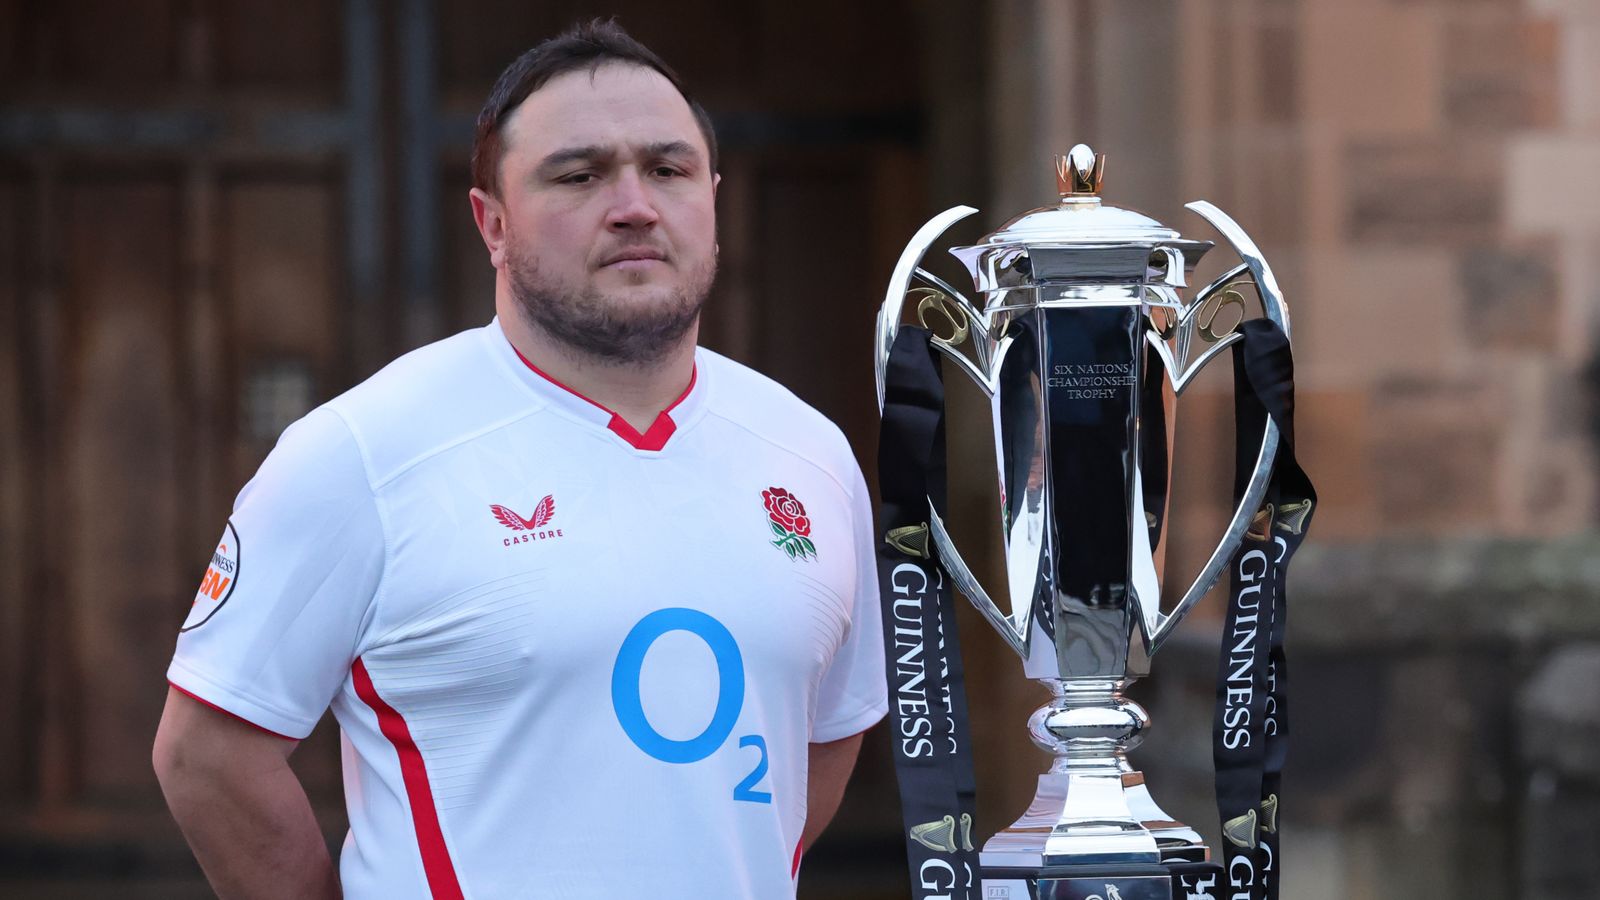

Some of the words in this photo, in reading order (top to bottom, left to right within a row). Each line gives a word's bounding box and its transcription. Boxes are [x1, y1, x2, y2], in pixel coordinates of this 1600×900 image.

[1054, 365, 1073, 375] SIX
[1076, 364, 1129, 374] NATIONS
[1047, 376, 1137, 387] CHAMPIONSHIP
[1067, 389, 1117, 400] TROPHY
[503, 529, 564, 547] CASTORE
[1223, 549, 1268, 750] GUINNESS
[891, 562, 934, 758] GUINNESS
[611, 607, 772, 804] O2
